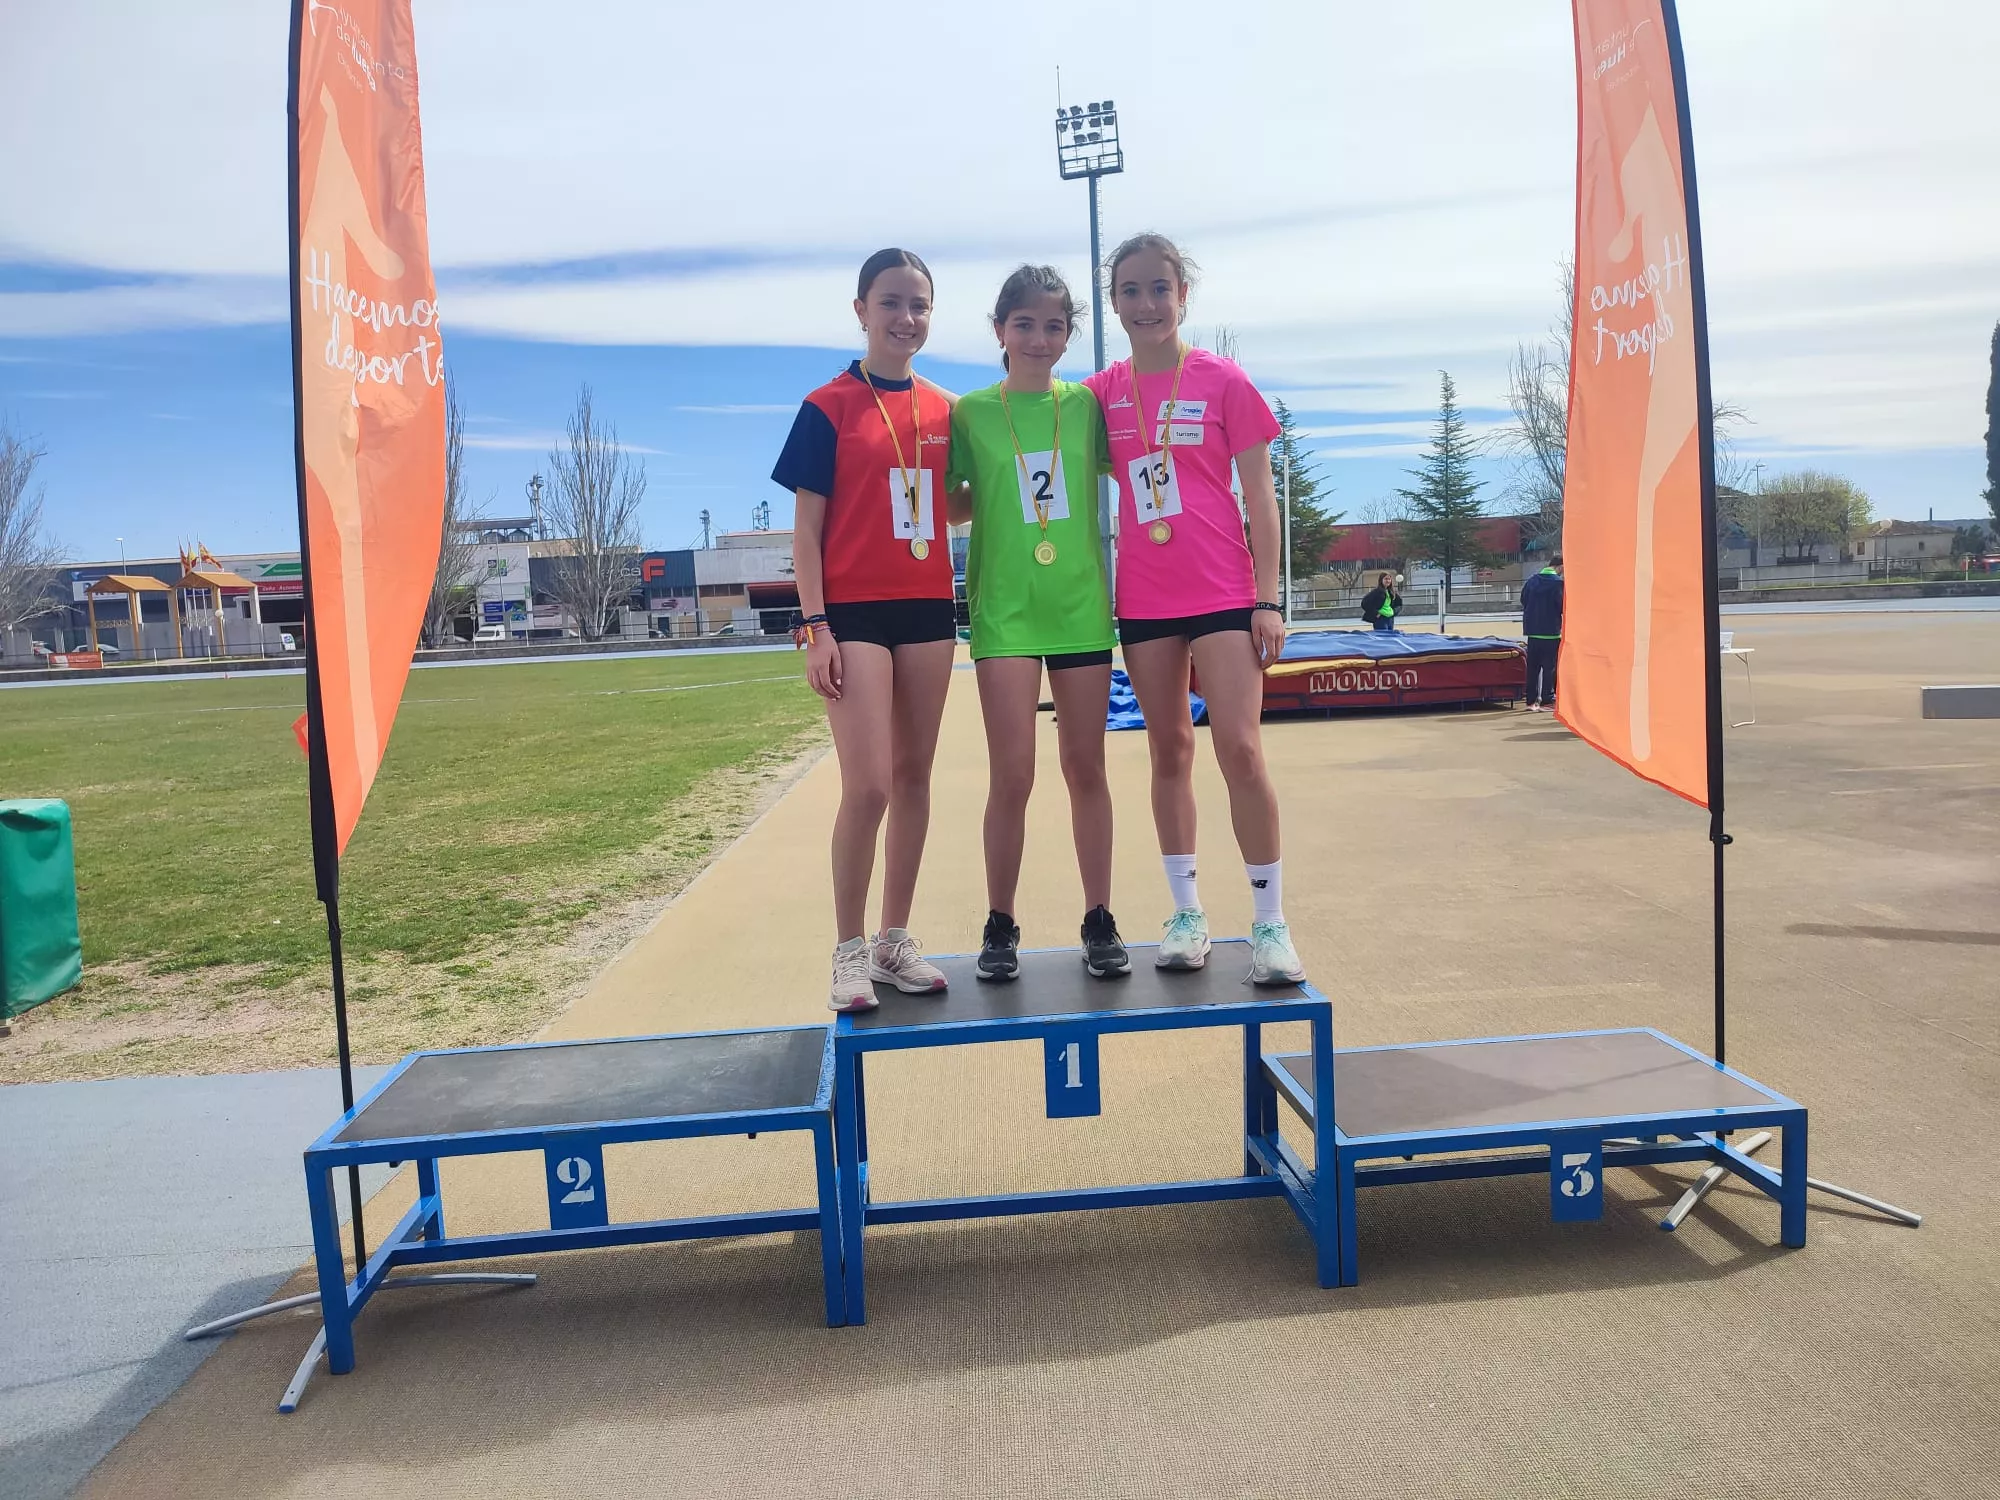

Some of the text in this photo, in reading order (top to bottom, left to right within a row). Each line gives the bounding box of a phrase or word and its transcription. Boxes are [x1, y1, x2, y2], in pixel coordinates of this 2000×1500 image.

[1032, 471, 1054, 501] 2
[1139, 462, 1170, 490] 13
[1310, 669, 1418, 693] MONDO
[1058, 1042, 1083, 1089] 1
[556, 1156, 595, 1204] 2
[1561, 1152, 1594, 1197] 3
